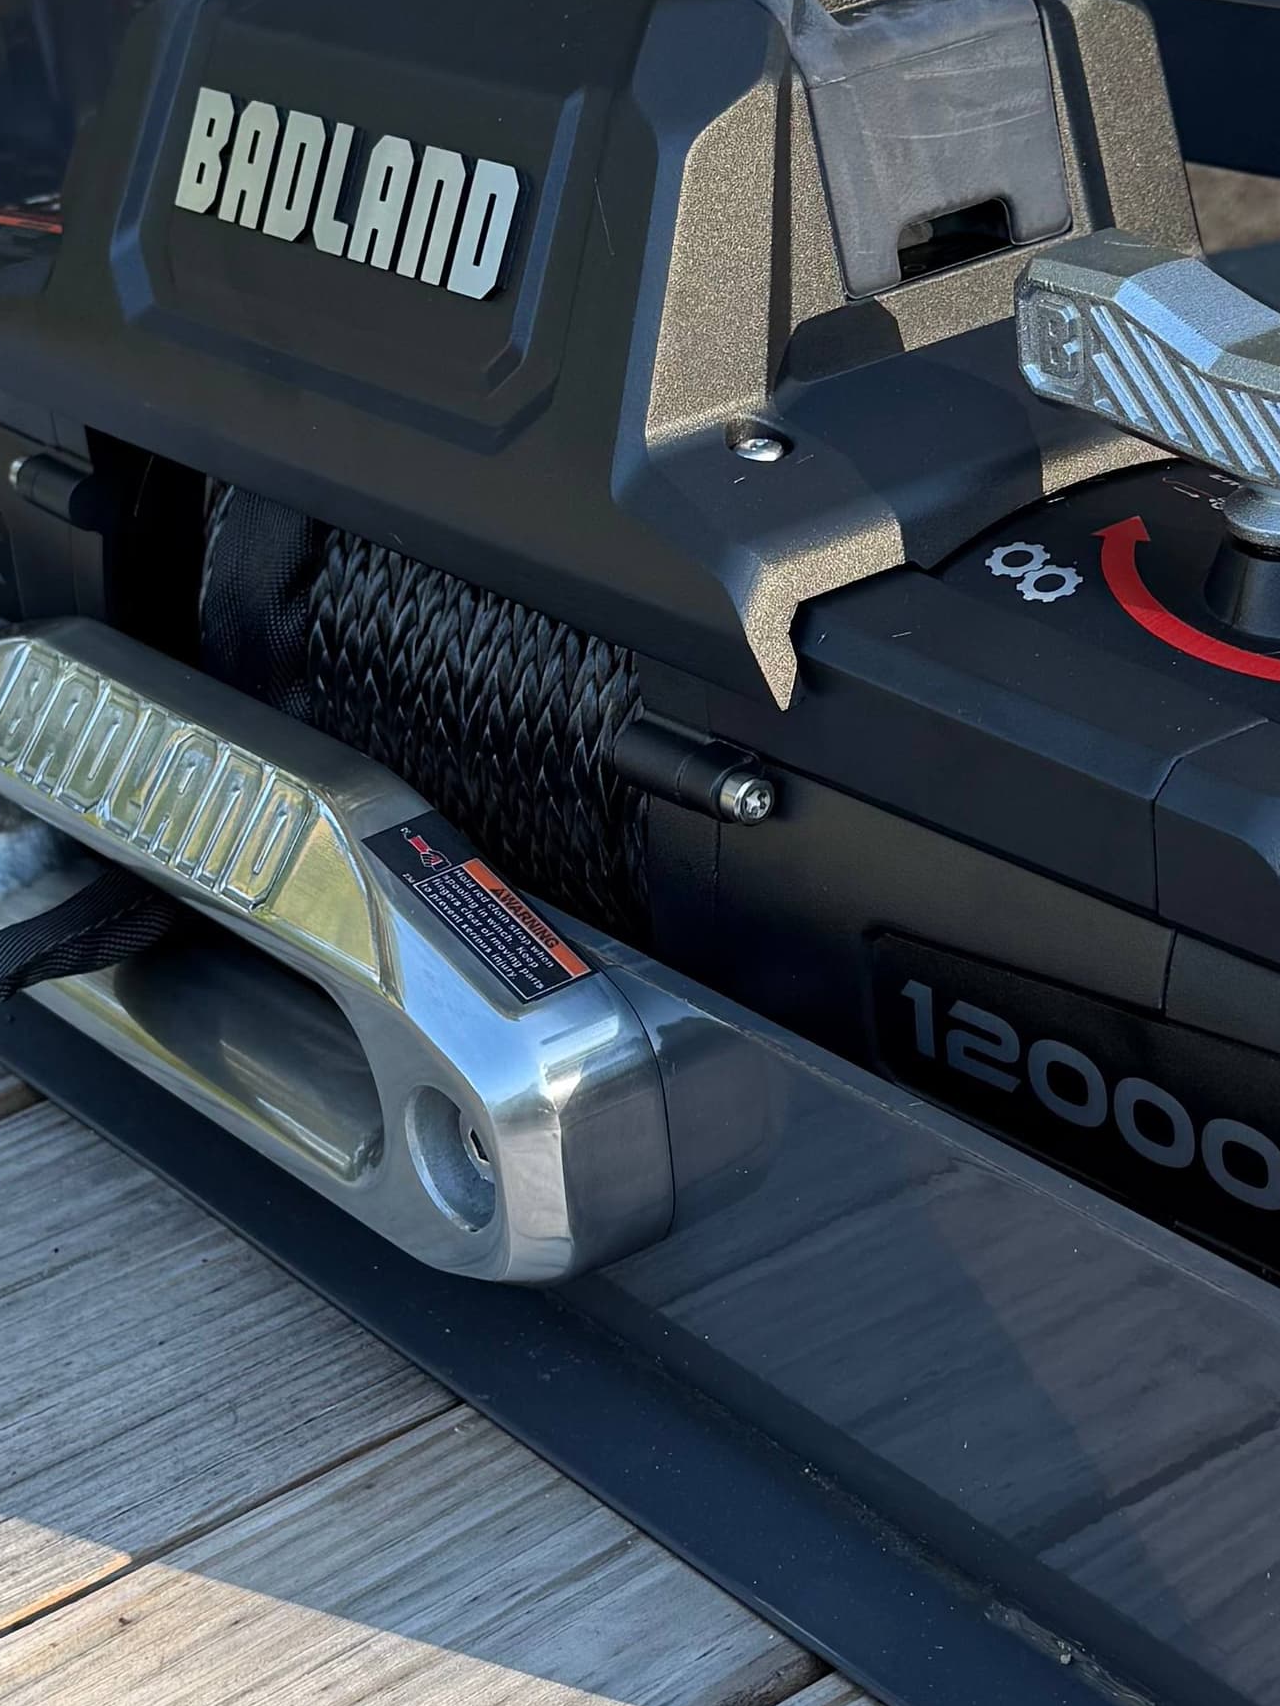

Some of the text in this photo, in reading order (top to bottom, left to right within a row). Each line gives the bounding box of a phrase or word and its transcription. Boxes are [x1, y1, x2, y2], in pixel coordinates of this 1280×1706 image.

[175, 87, 520, 300] BADLAND
[421, 883, 432, 893] to
[429, 893, 464, 923] prevent
[461, 924, 492, 953] serious
[432, 878, 544, 990] fingers clear of moving parts
[442, 874, 479, 909] spooling
[477, 908, 489, 918] in
[515, 946, 539, 968] Keep
[453, 869, 554, 969] Hold red cloth strap when
[500, 892, 560, 949] WARNING
